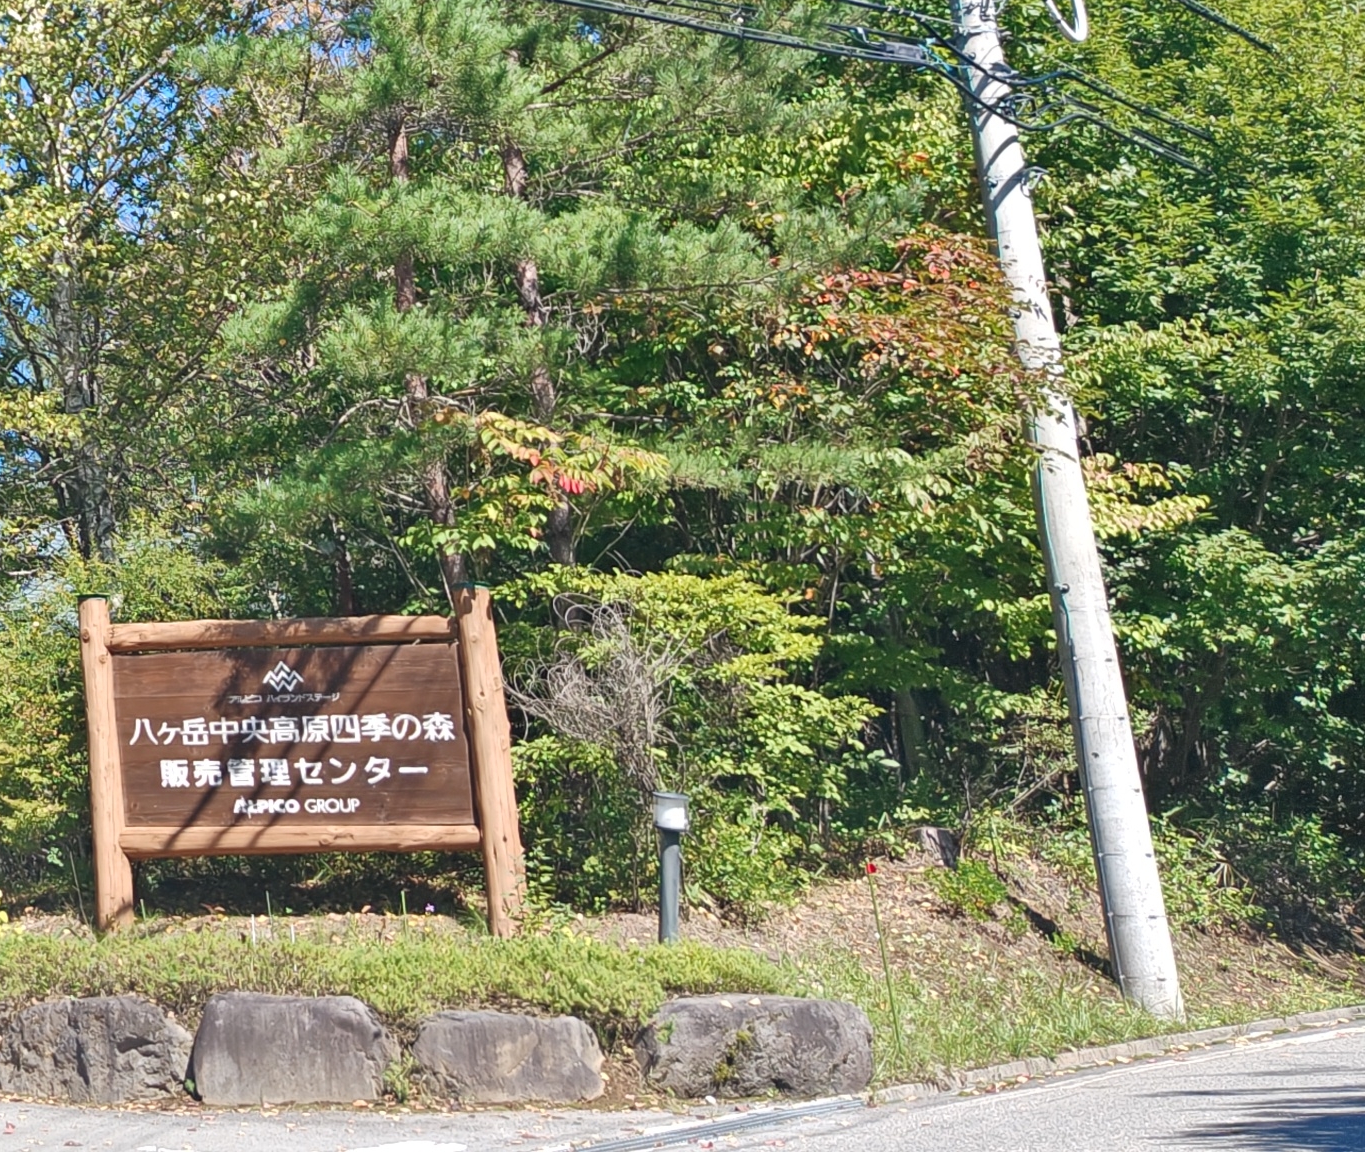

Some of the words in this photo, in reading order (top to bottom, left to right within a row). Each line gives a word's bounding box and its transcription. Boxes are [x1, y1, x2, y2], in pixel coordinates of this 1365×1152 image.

[129, 712, 455, 746] 八ヶ岳中央高原四季の森
[160, 757, 429, 788] 販売管理センター
[233, 797, 301, 816] ALPICO
[304, 798, 361, 814] GROUP
